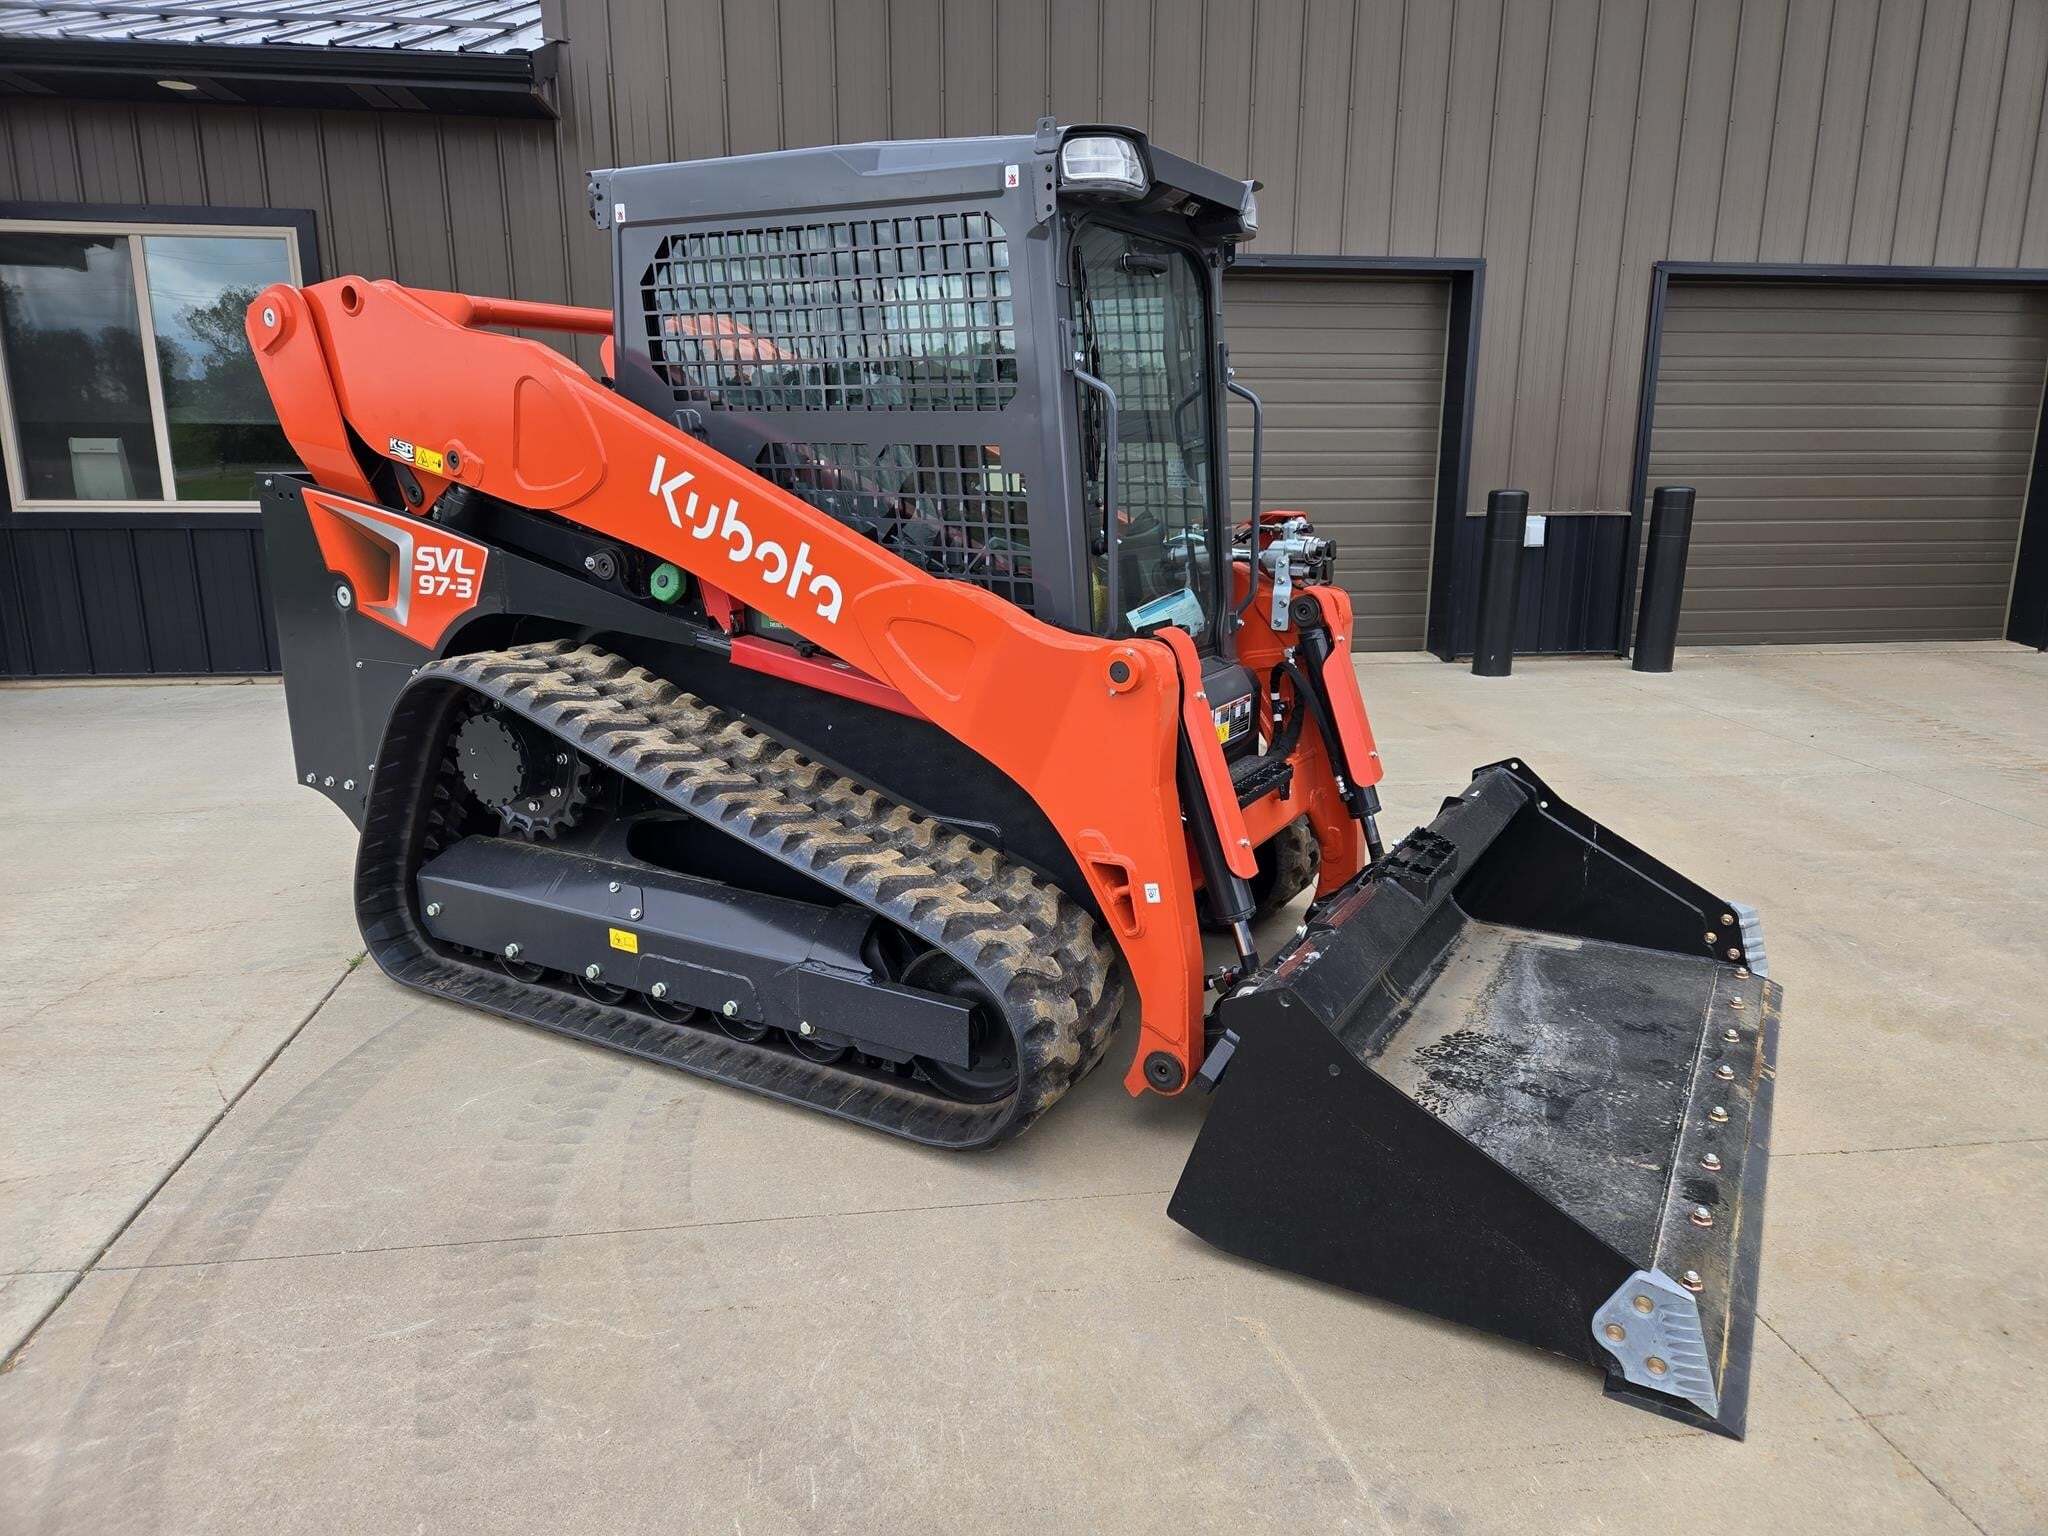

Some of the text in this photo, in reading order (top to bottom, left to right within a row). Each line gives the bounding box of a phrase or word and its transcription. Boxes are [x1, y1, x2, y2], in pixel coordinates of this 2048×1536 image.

[389, 437, 413, 456] KSR
[648, 453, 843, 625] Kubota
[413, 545, 476, 576] SVL
[418, 574, 473, 599] 97-3
